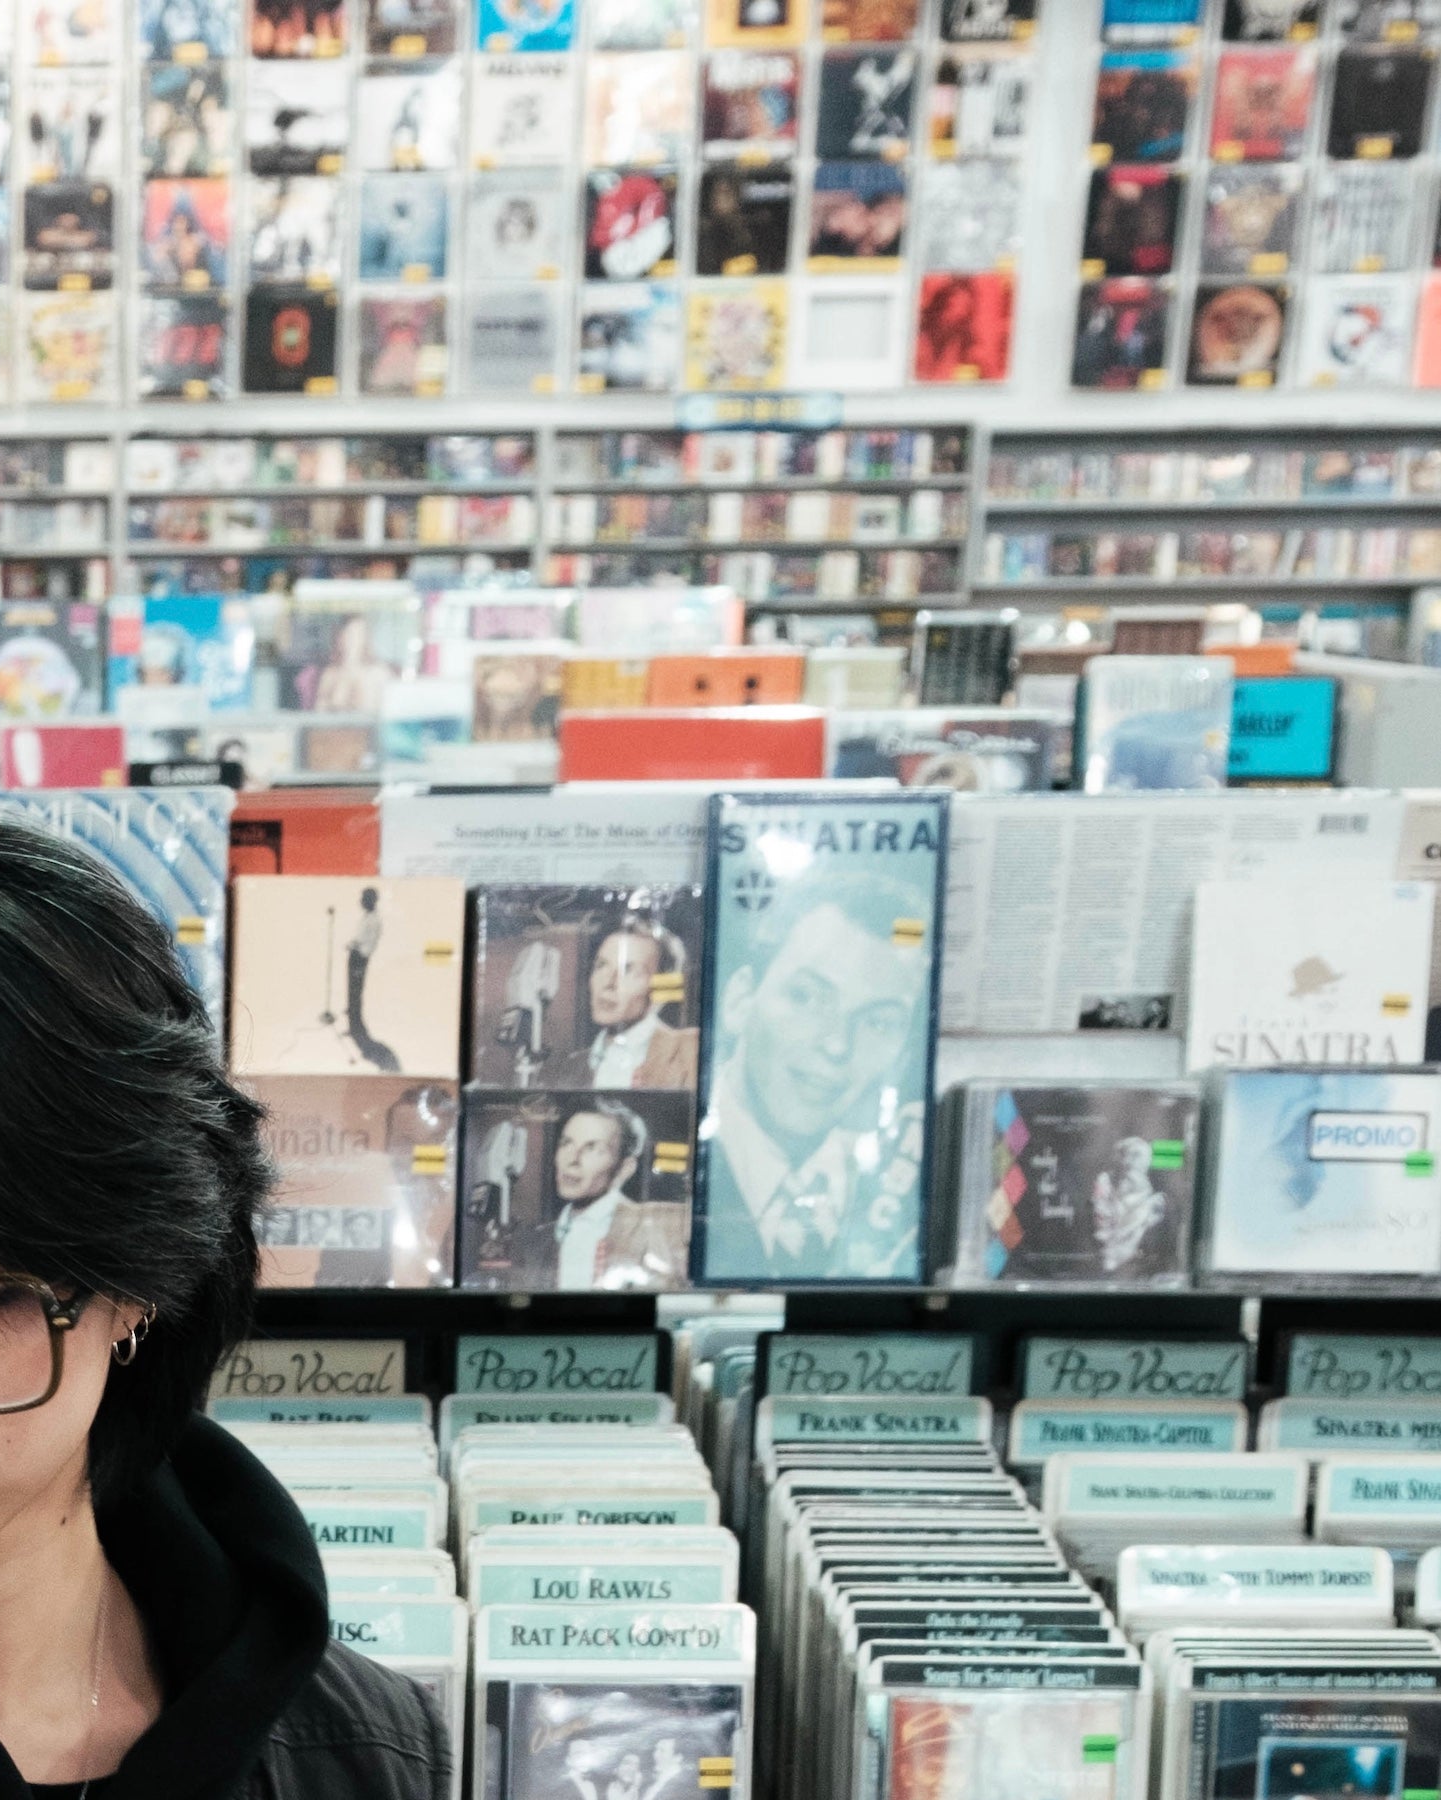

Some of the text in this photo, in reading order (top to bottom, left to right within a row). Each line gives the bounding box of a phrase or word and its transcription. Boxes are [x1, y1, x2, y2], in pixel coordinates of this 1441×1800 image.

[718, 819, 938, 852] SATRA
[1213, 1032, 1401, 1063] SINATRA
[270, 1122, 371, 1156] inatra
[1315, 1124, 1418, 1147] PROMO
[218, 1350, 395, 1395] Pop Vocal
[467, 1346, 649, 1392] Pop Vocal
[776, 1349, 962, 1394] Pop Vocal
[1044, 1346, 1240, 1398] Pop Vocal
[1296, 1347, 1441, 1398] Pop Voc
[798, 1411, 961, 1433] FRANK SINATRA
[1314, 1415, 1402, 1437] SINATRA
[532, 1576, 672, 1600] LOU RAWLS
[510, 1623, 721, 1648] RAT PACK (CONT'D)
[923, 1667, 960, 1686] Songs
[962, 1666, 983, 1684] for
